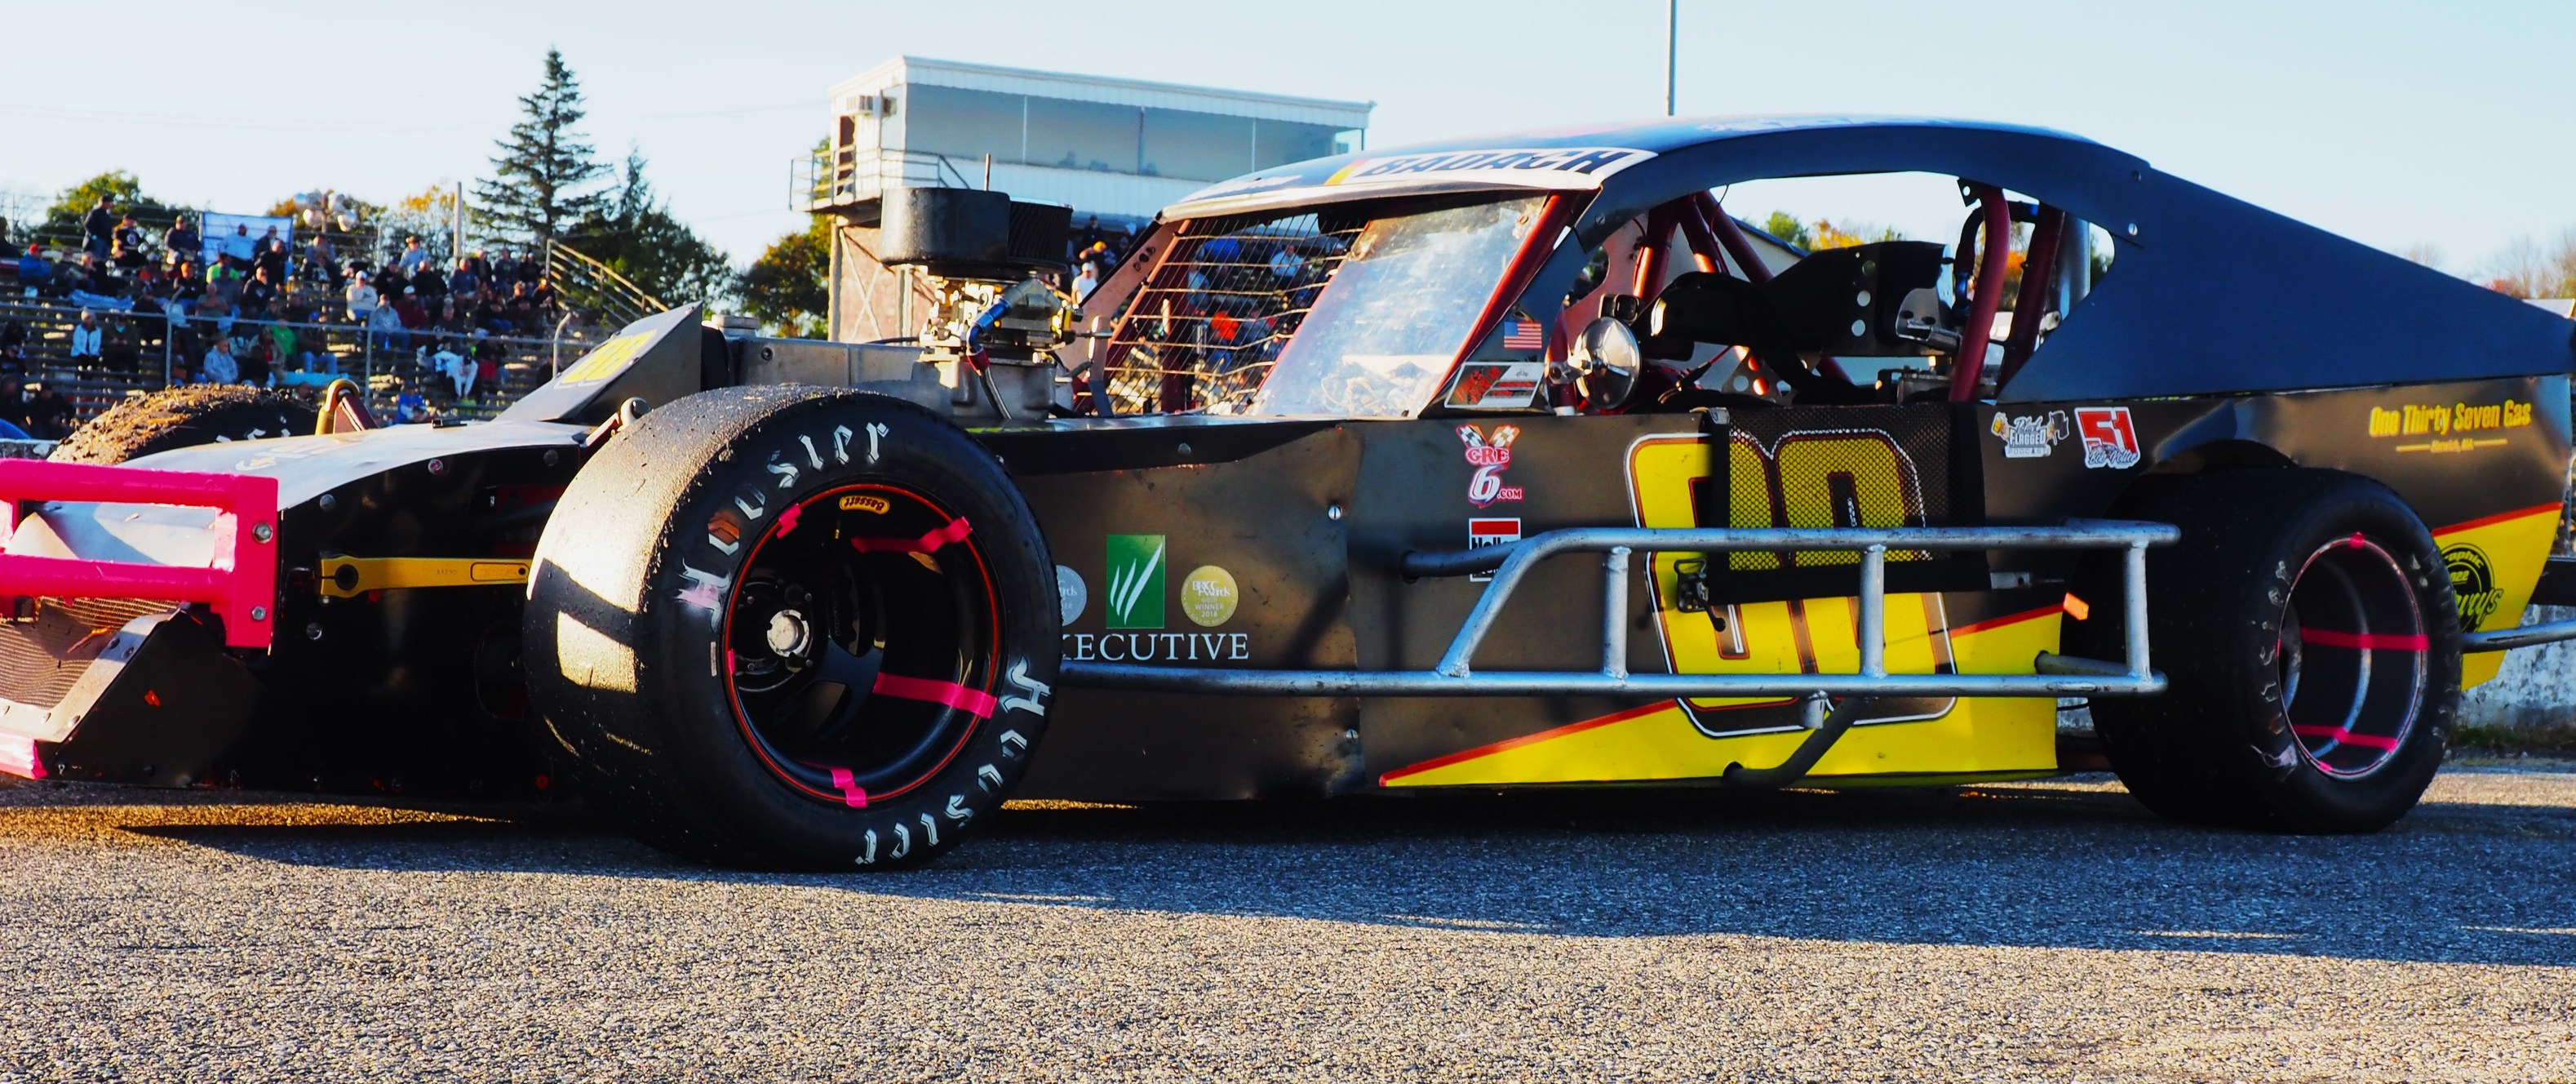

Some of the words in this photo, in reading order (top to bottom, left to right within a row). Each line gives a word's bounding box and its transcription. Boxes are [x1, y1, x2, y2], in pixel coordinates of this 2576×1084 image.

[2369, 406, 2401, 437] One
[2403, 405, 2451, 435] Thirty
[2454, 402, 2501, 431] Seven
[2503, 399, 2533, 428] Gas
[2010, 429, 2046, 445] FLAGGED
[2077, 410, 2139, 454] 51
[1466, 448, 1510, 464] GRE
[844, 496, 885, 512] Bassett
[2450, 571, 2470, 582] 022
[1195, 603, 1224, 611] WINNER
[854, 655, 1052, 864] Hoosier
